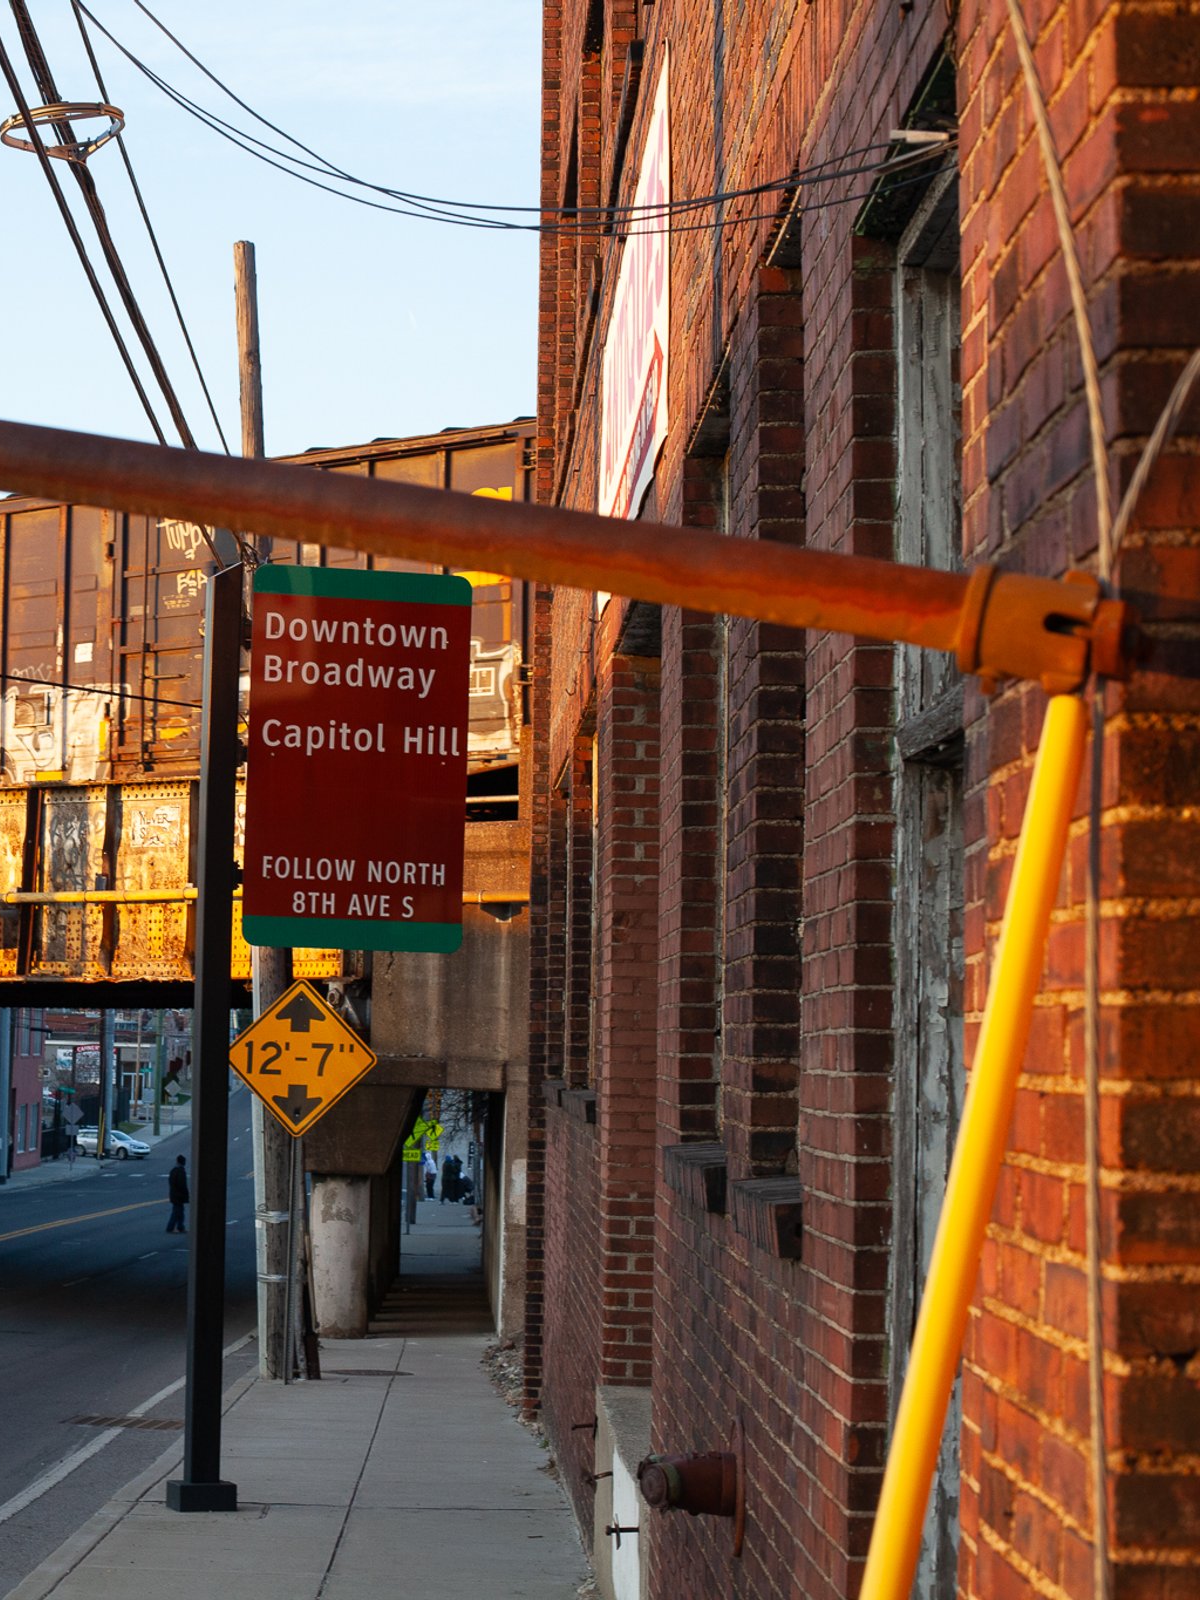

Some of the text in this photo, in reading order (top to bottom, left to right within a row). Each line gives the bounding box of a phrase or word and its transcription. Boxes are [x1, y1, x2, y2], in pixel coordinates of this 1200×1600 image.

[264, 612, 449, 650] Downtown
[263, 654, 436, 699] Broadway
[261, 719, 460, 756] Capitol Hill
[262, 855, 446, 887] FOLLOW NORTH
[292, 891, 415, 919] 8TH AVE S
